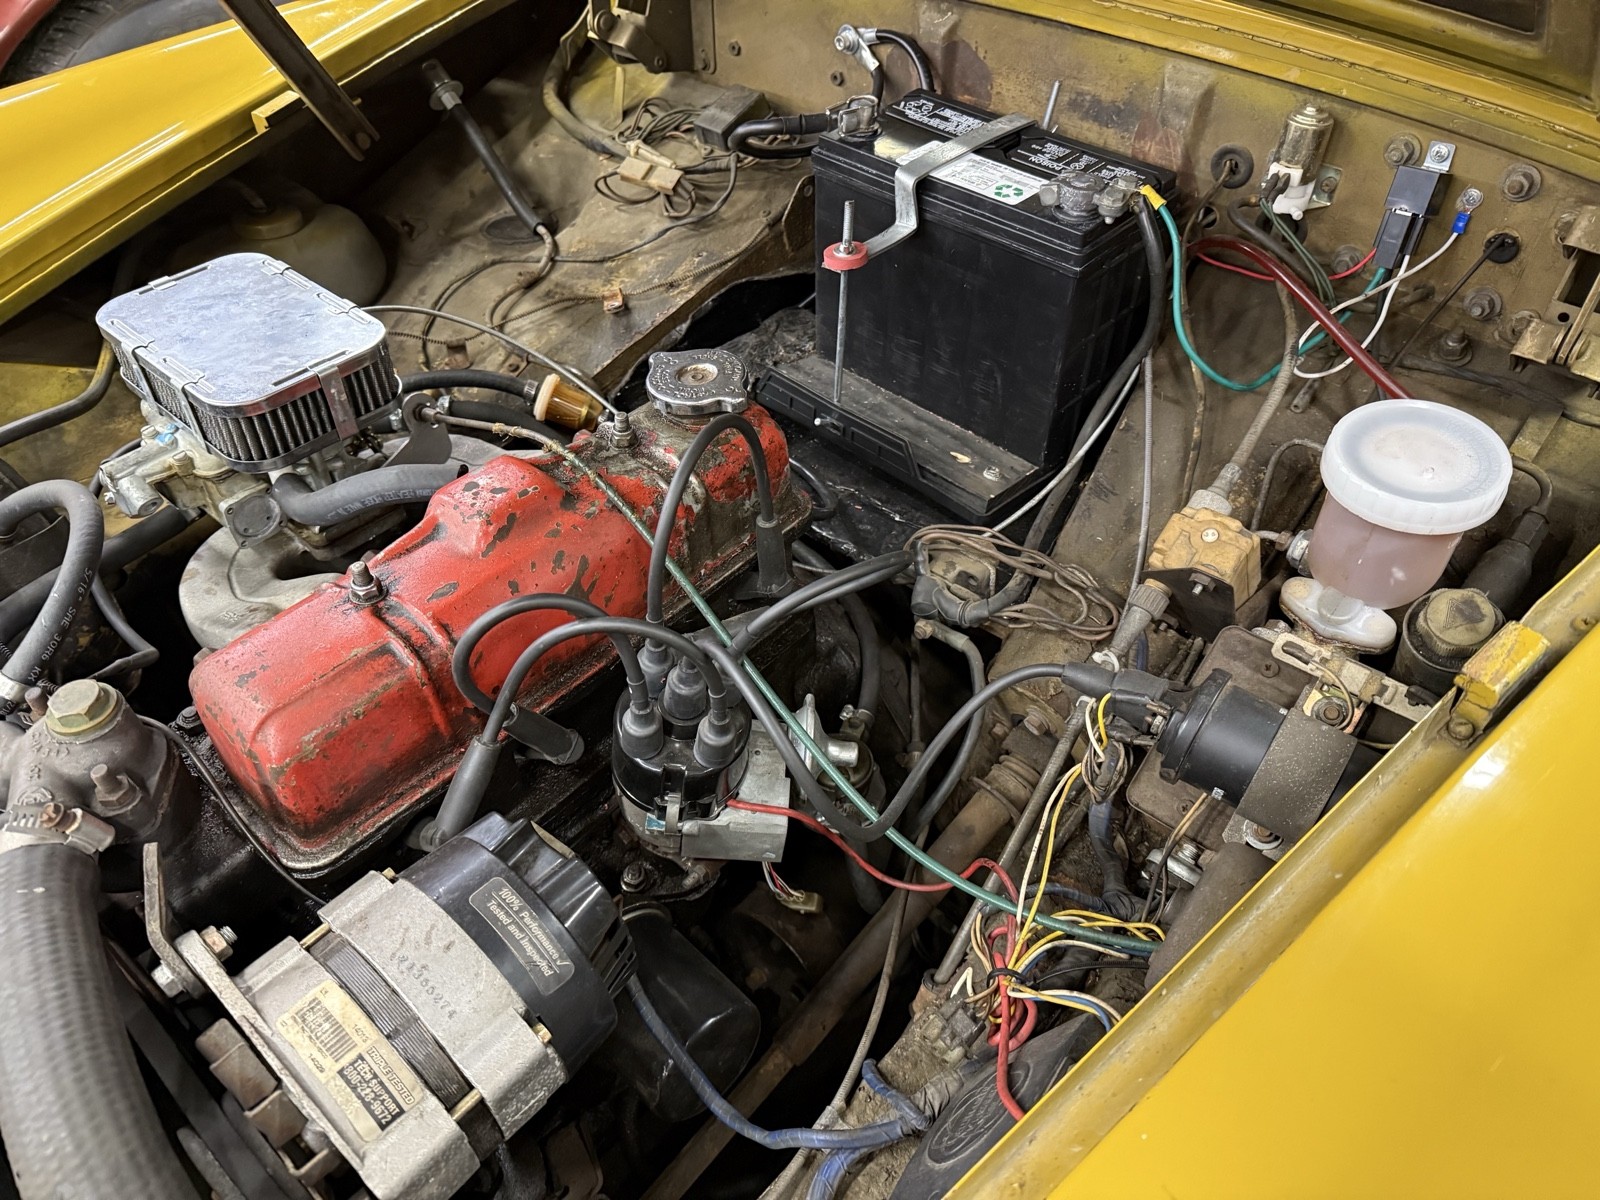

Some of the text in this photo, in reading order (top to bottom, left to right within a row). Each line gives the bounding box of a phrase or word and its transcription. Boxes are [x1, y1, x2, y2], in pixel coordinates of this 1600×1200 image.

[1028, 156, 1062, 170] POISON
[59, 606, 76, 630] SAE
[486, 898, 554, 978] Tested and Inspected
[498, 885, 561, 960] 100% Performance
[352, 1058, 400, 1116] TECH SUPPORT
[367, 1045, 416, 1105] TRIPLE TESTED
